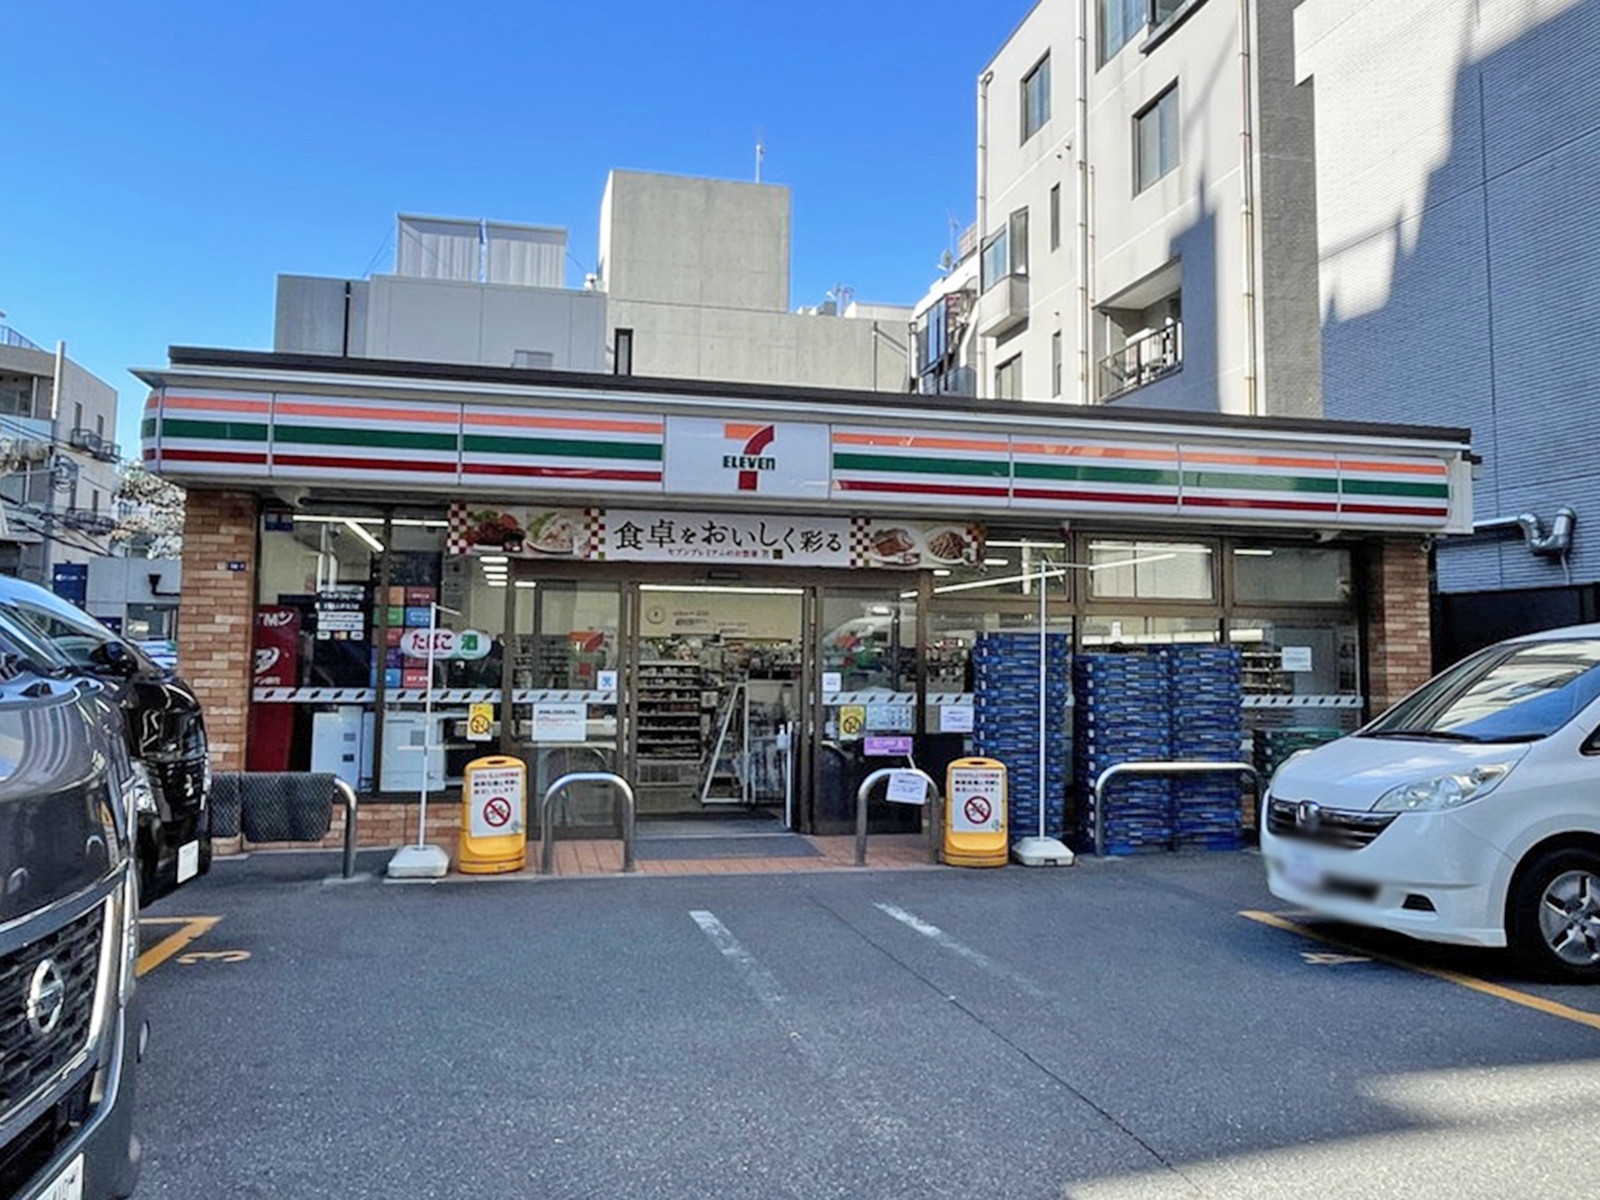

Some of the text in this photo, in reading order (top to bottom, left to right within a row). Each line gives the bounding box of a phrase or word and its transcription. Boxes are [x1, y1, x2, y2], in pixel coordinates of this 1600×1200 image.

[613, 519, 842, 553] 食卓をおいしく彩る
[460, 634, 479, 651] 酒
